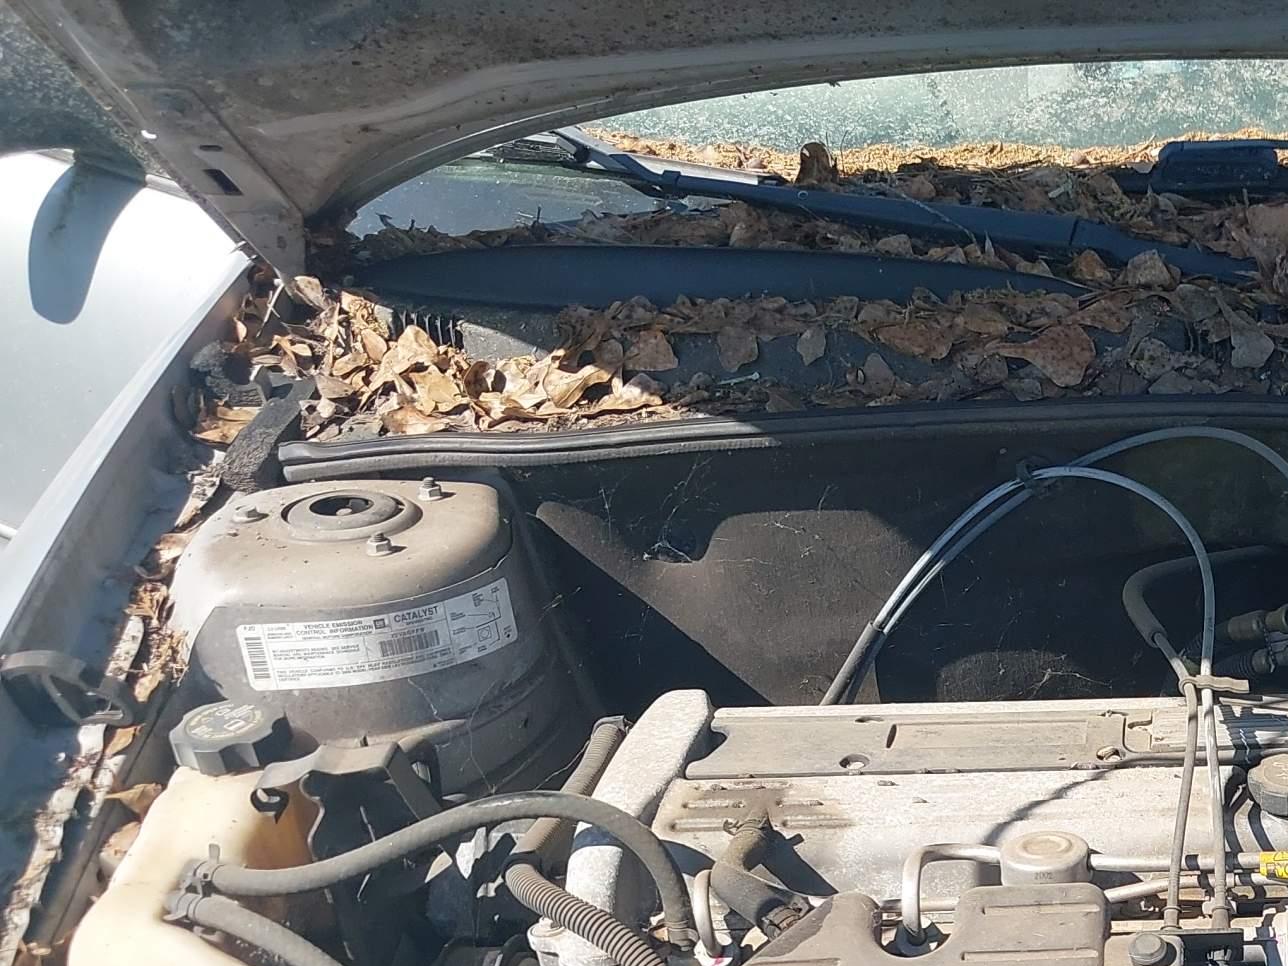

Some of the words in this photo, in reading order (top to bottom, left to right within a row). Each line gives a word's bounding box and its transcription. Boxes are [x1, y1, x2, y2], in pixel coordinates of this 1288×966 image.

[393, 606, 439, 623] CATALYST
[332, 620, 363, 628] EMISSION
[328, 625, 374, 634] INFORMATION
